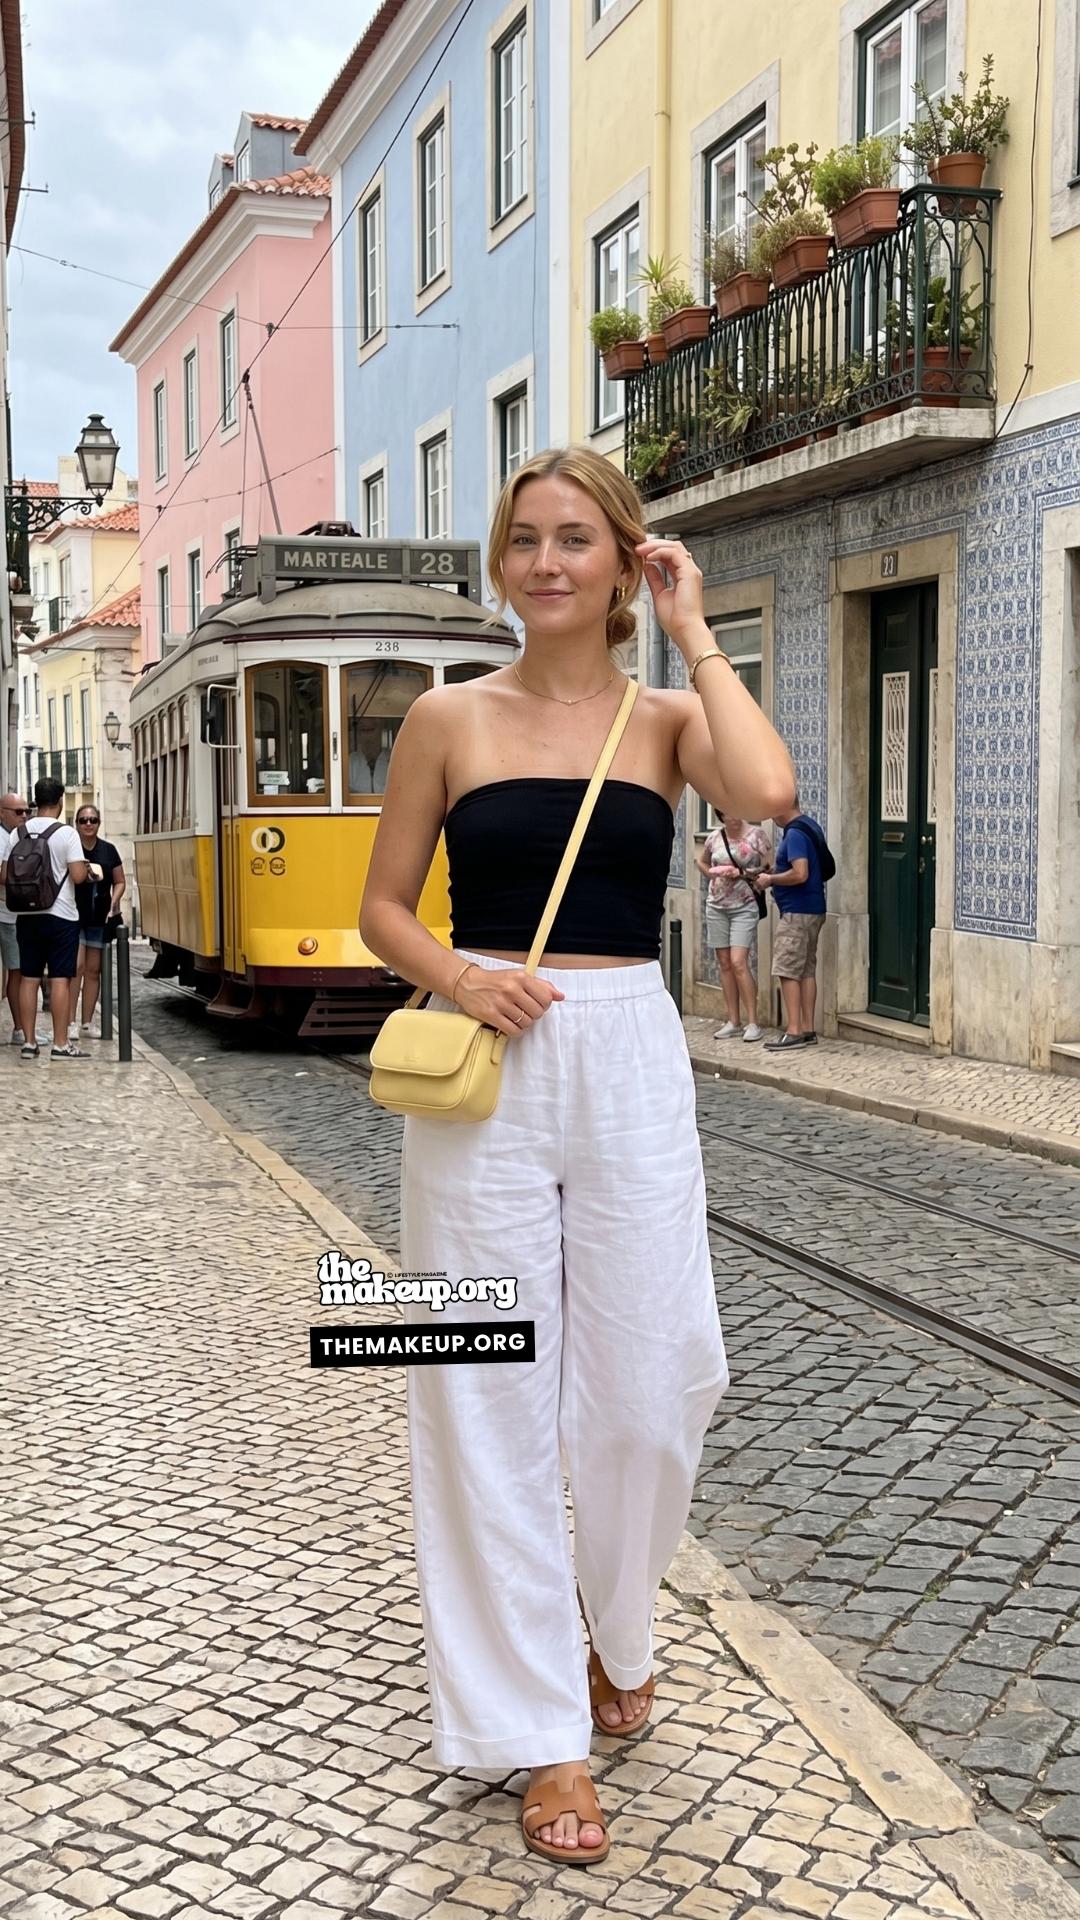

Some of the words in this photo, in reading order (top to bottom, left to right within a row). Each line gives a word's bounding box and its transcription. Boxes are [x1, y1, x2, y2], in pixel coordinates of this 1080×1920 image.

[284, 550, 388, 569] MARTEALE
[420, 552, 454, 575] 28
[375, 641, 400, 652] 238
